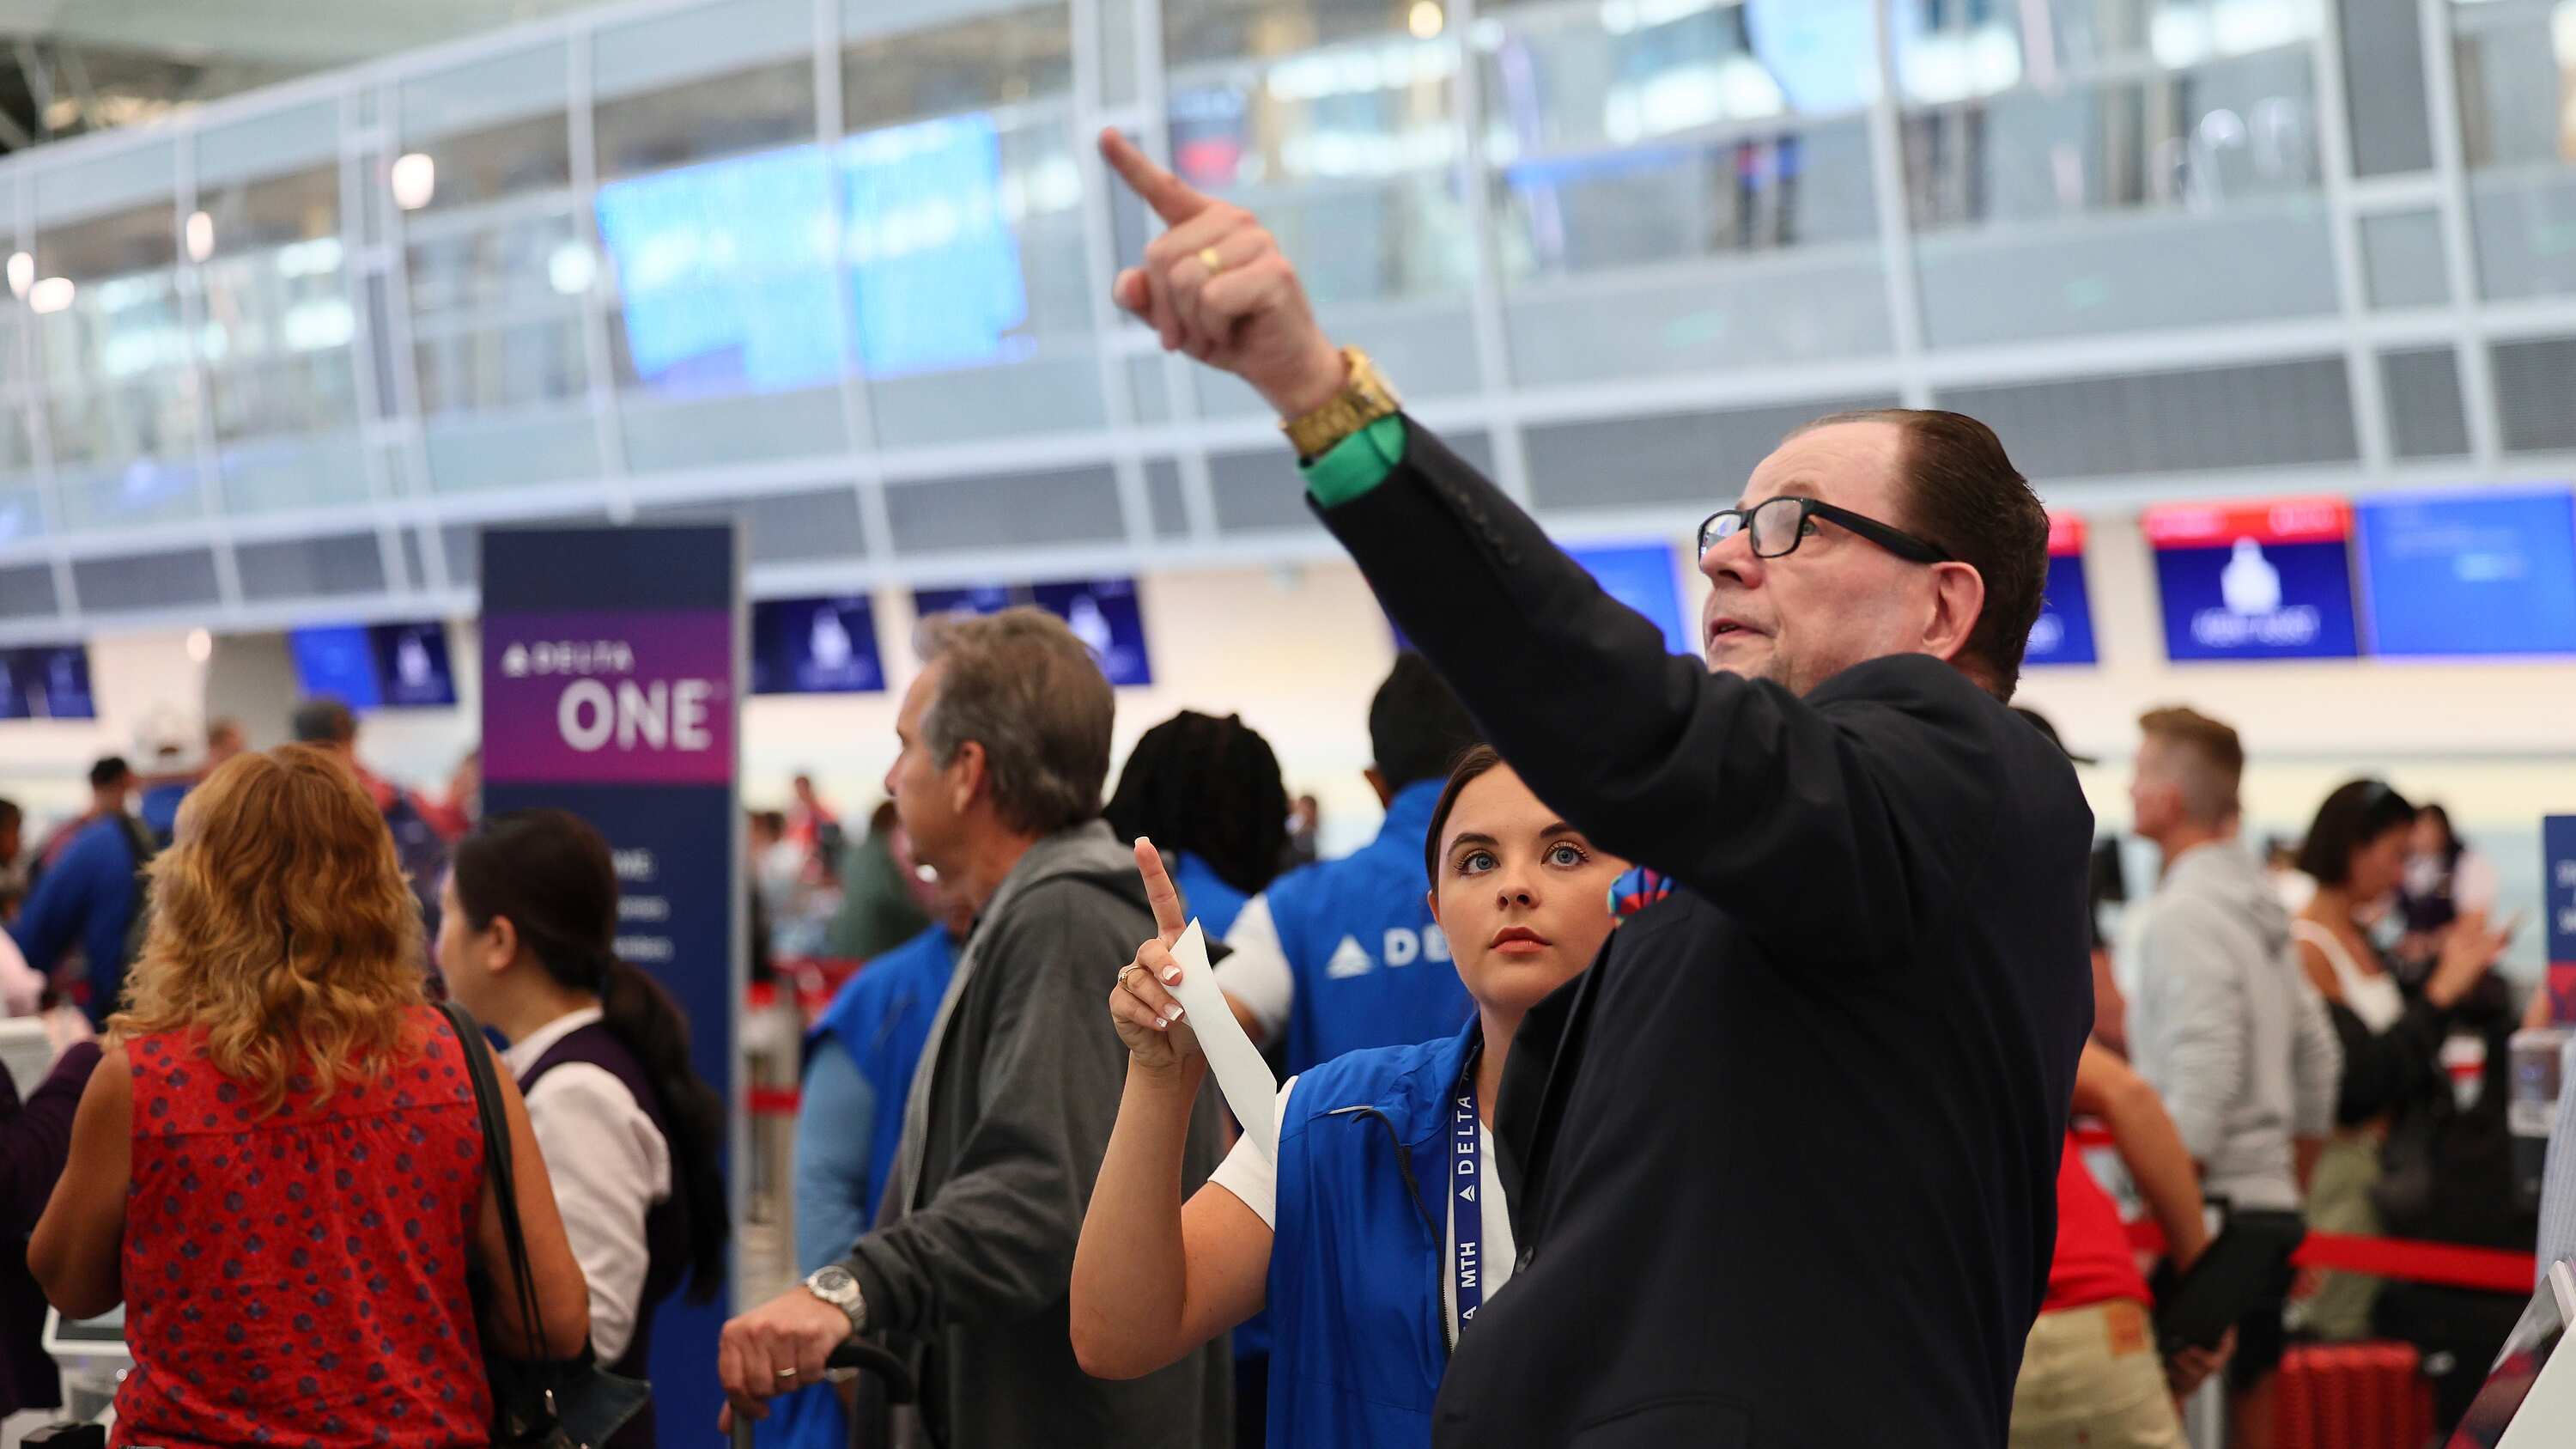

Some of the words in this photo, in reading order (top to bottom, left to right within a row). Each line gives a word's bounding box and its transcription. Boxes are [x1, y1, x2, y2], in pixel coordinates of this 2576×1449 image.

[531, 642, 634, 674] DELTA
[559, 679, 712, 752] ONE
[1457, 1096, 1474, 1175] DELTA
[1460, 1241, 1476, 1288] MTH
